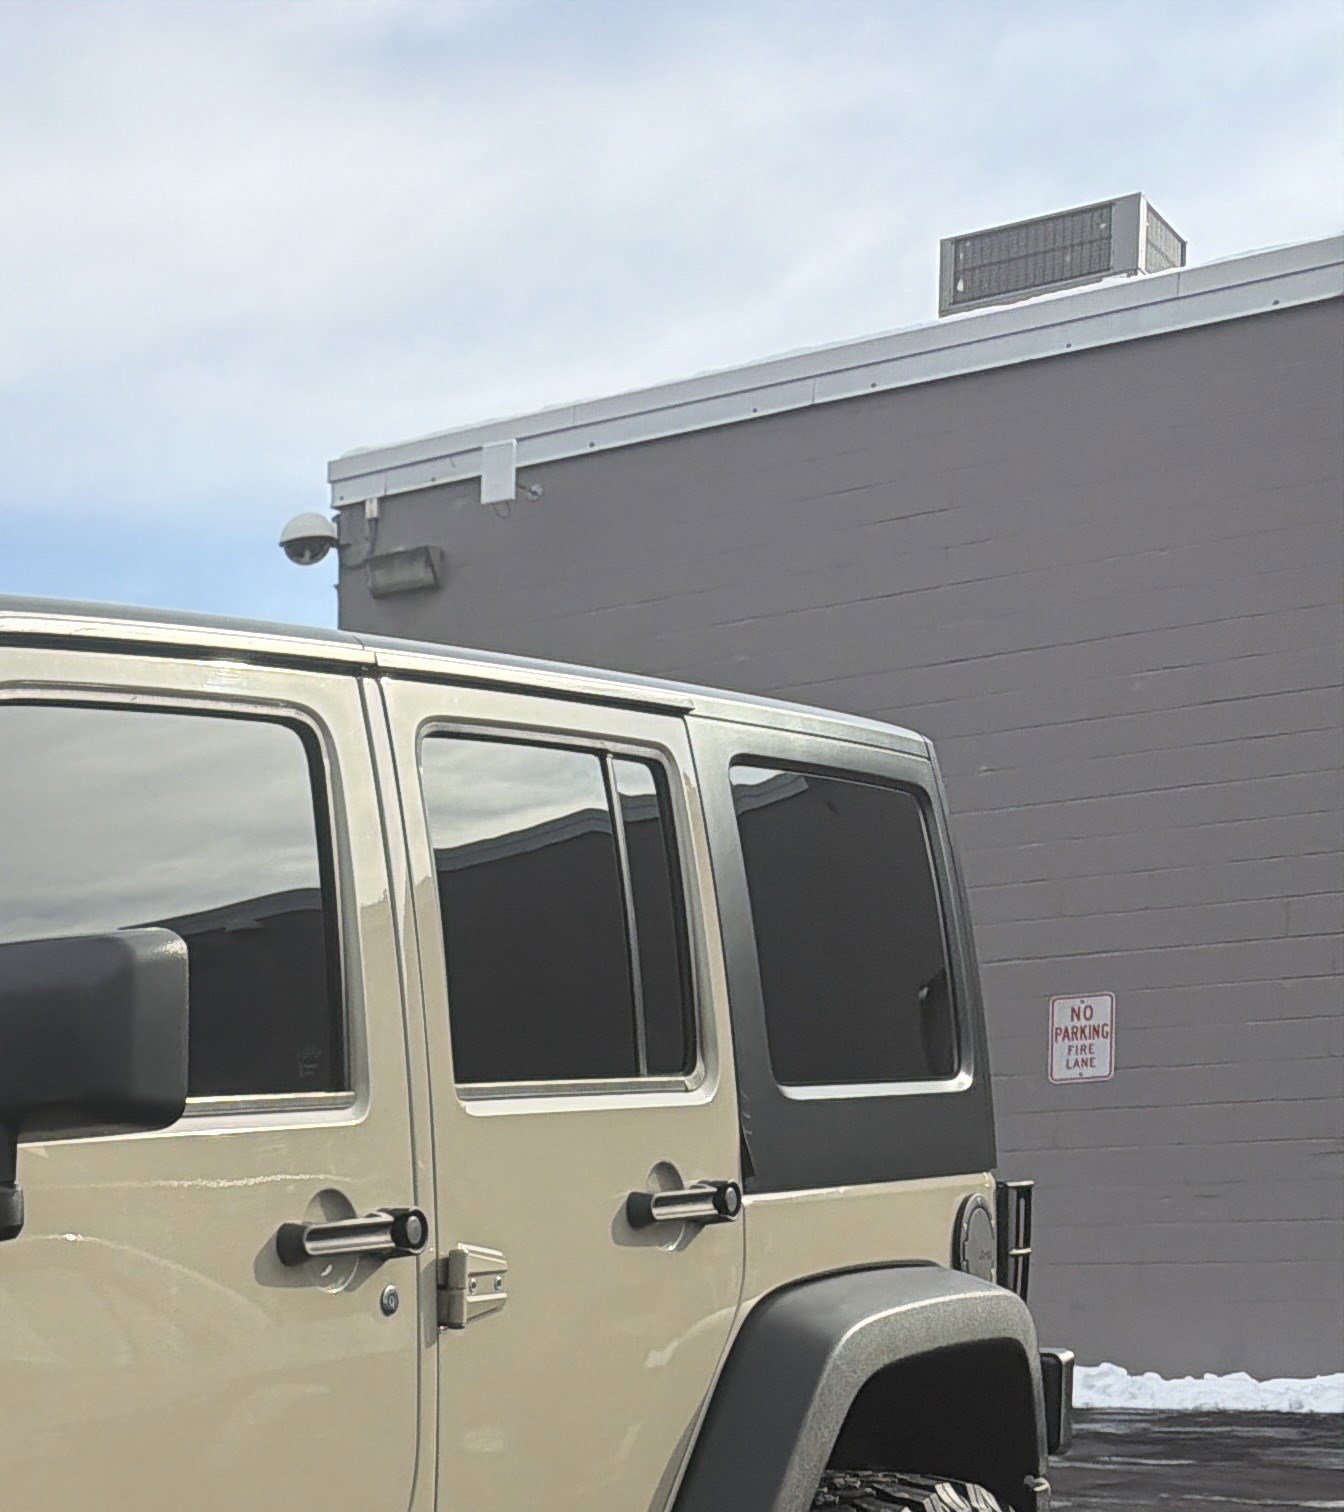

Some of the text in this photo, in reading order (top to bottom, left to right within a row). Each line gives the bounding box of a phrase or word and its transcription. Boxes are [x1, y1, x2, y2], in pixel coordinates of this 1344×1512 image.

[1070, 1005, 1094, 1022] NO
[1054, 1023, 1109, 1042] PARKING
[1067, 1043, 1095, 1056] FIRE
[1066, 1056, 1097, 1070] LANE
